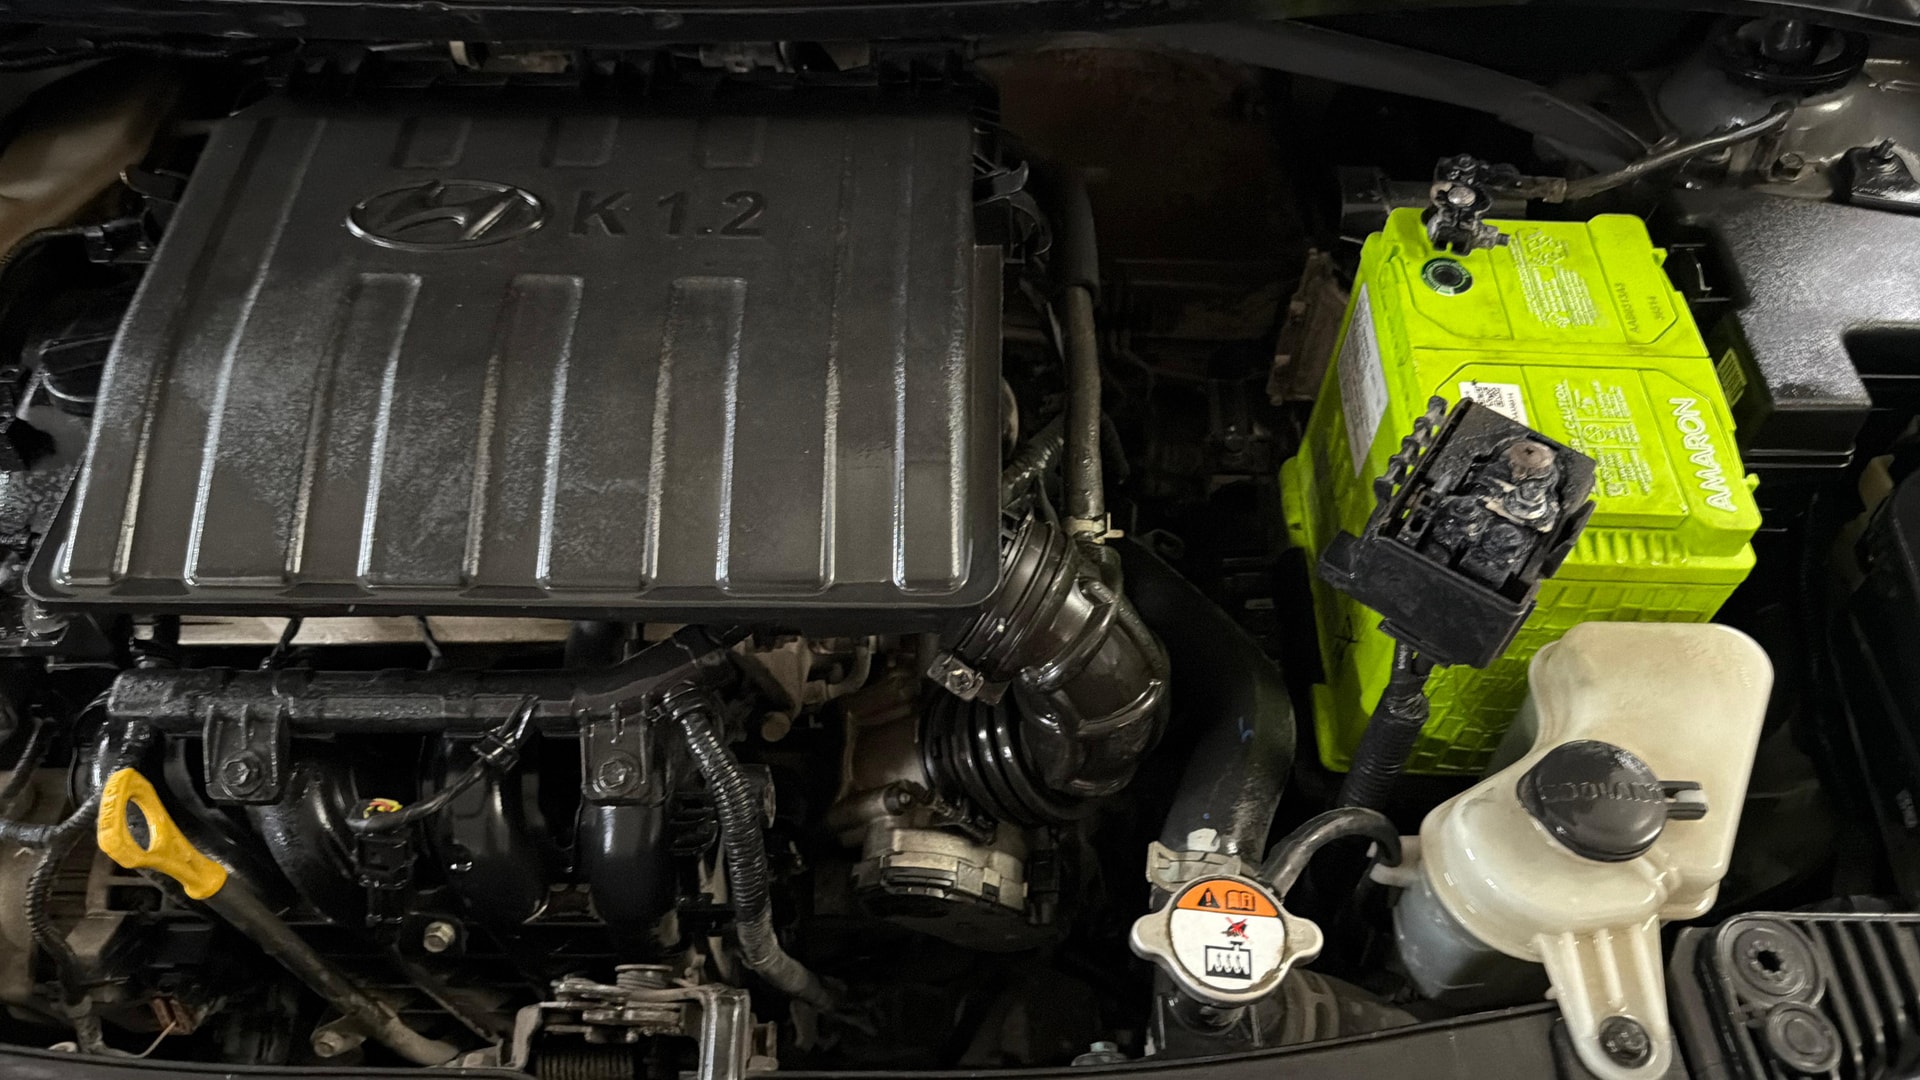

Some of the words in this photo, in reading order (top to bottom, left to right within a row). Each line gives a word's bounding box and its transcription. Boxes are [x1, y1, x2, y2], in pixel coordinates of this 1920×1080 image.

[568, 190, 632, 238] K
[656, 190, 768, 239] 1.2
[1668, 397, 1738, 513] AMARON
